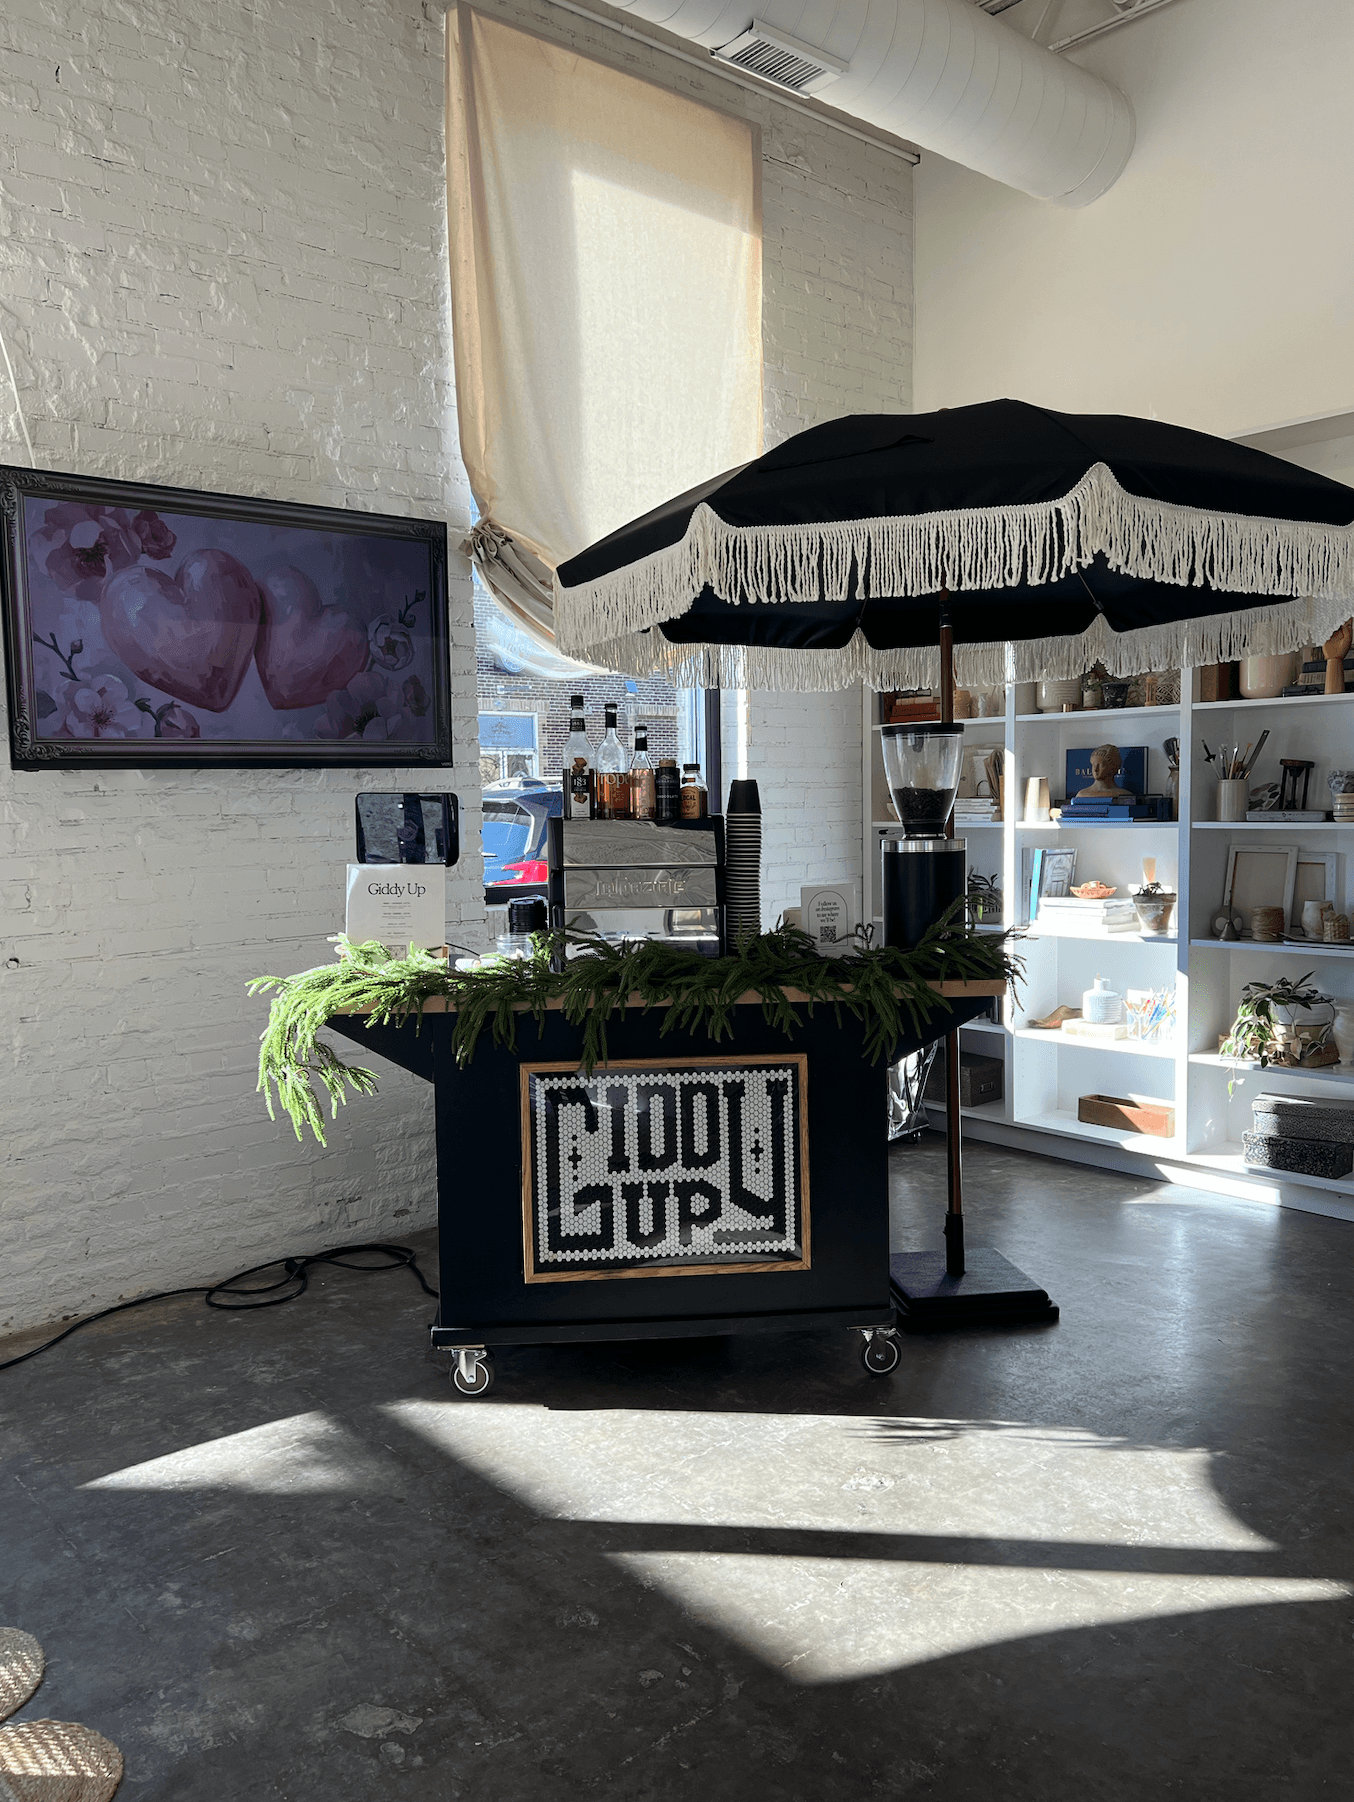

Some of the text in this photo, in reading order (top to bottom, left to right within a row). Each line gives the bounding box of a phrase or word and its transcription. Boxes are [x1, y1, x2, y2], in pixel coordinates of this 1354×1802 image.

[368, 882, 426, 898] Giddy Up
[621, 1180, 723, 1249] UP
